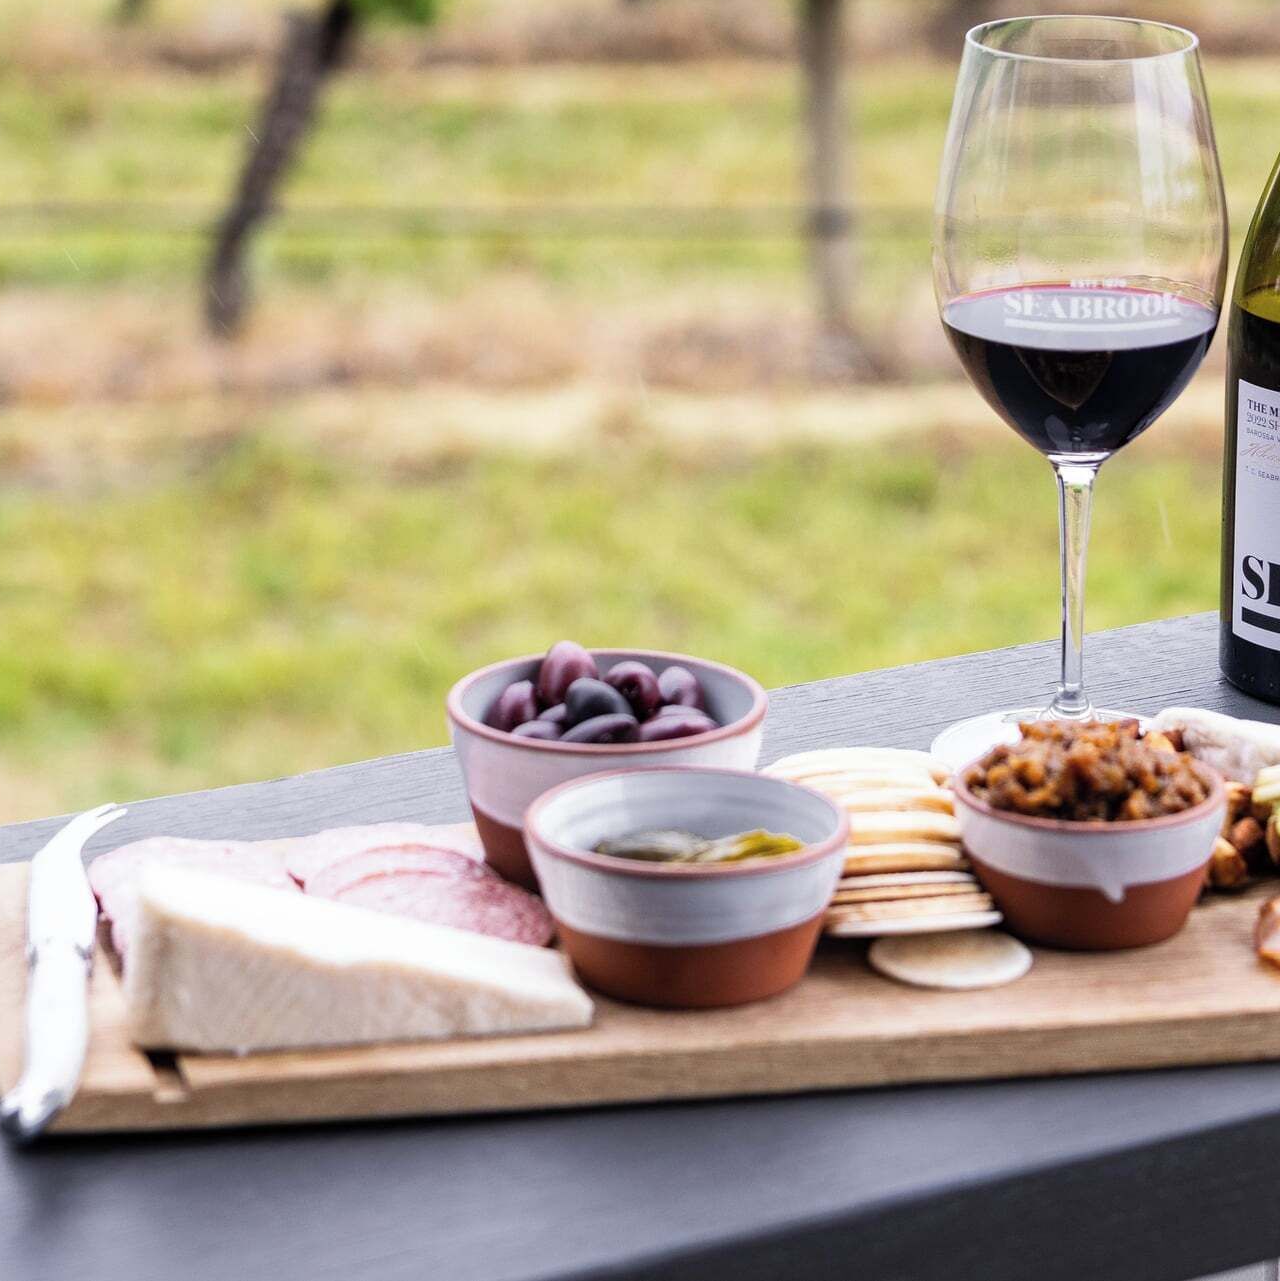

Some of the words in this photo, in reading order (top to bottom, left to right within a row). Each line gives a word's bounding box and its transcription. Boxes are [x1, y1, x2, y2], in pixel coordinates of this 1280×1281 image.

[1004, 289, 1182, 319] SEABROOK
[1247, 399, 1268, 414] THE
[1247, 412, 1267, 427] 2022
[1247, 428, 1275, 441] BAROSSA
